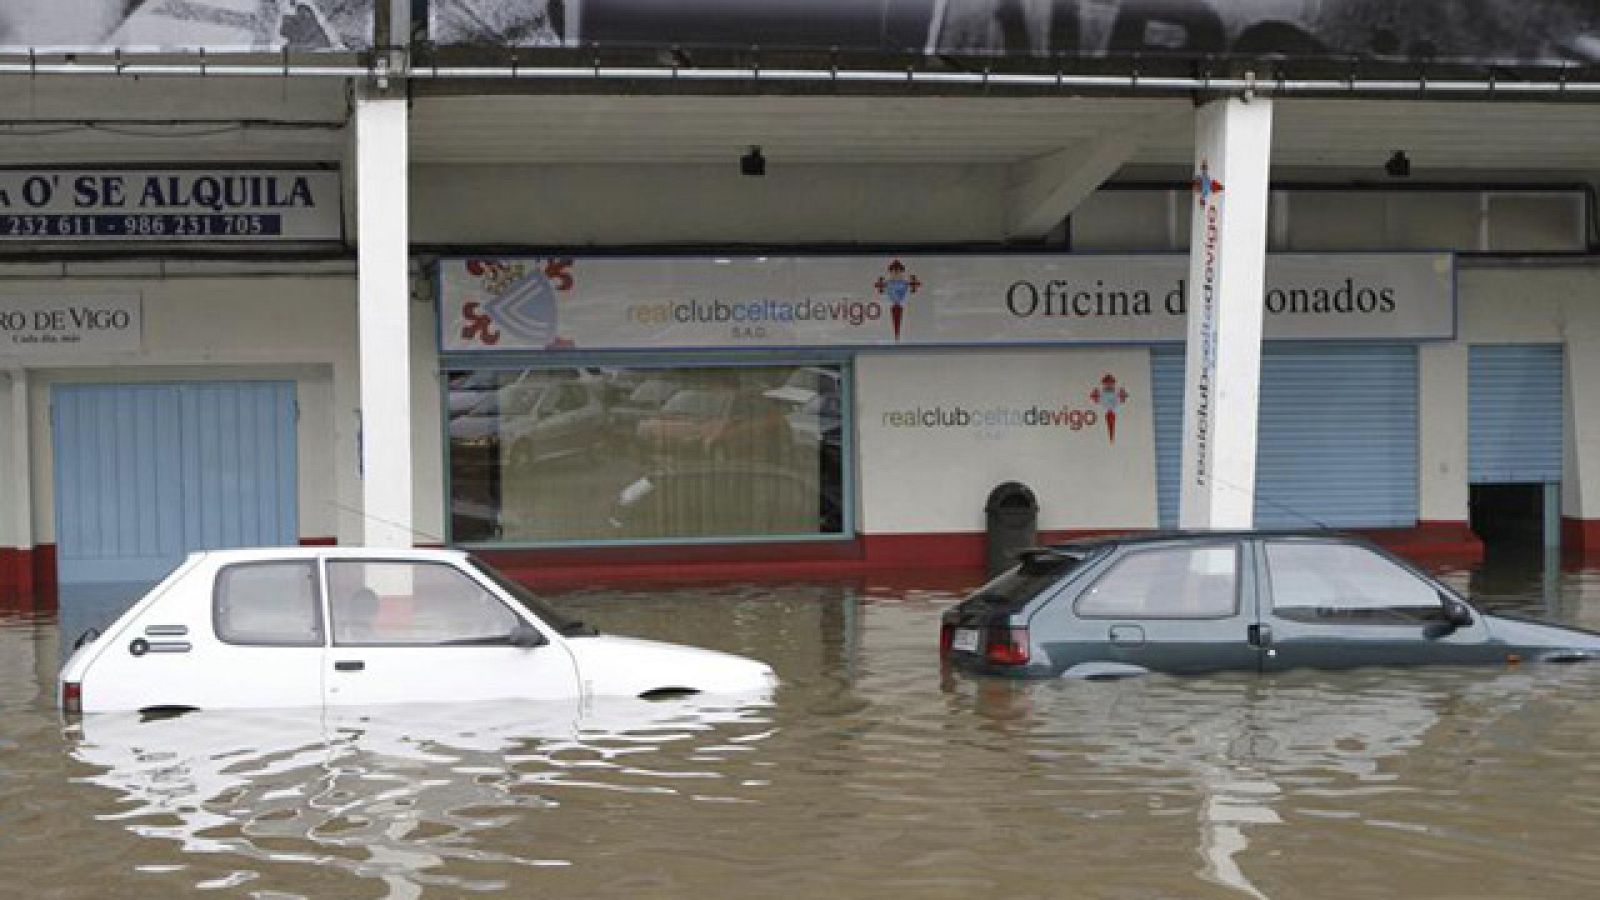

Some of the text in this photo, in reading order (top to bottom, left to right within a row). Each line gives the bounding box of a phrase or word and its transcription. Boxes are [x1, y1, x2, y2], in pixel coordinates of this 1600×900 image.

[74, 176, 125, 207] SE
[139, 176, 315, 210] ALQUILA
[124, 216, 166, 234] 986
[223, 216, 264, 234] 705
[1006, 279, 1396, 317] Oficina d onados
[34, 311, 66, 330] DE
[69, 307, 130, 330] VIGO
